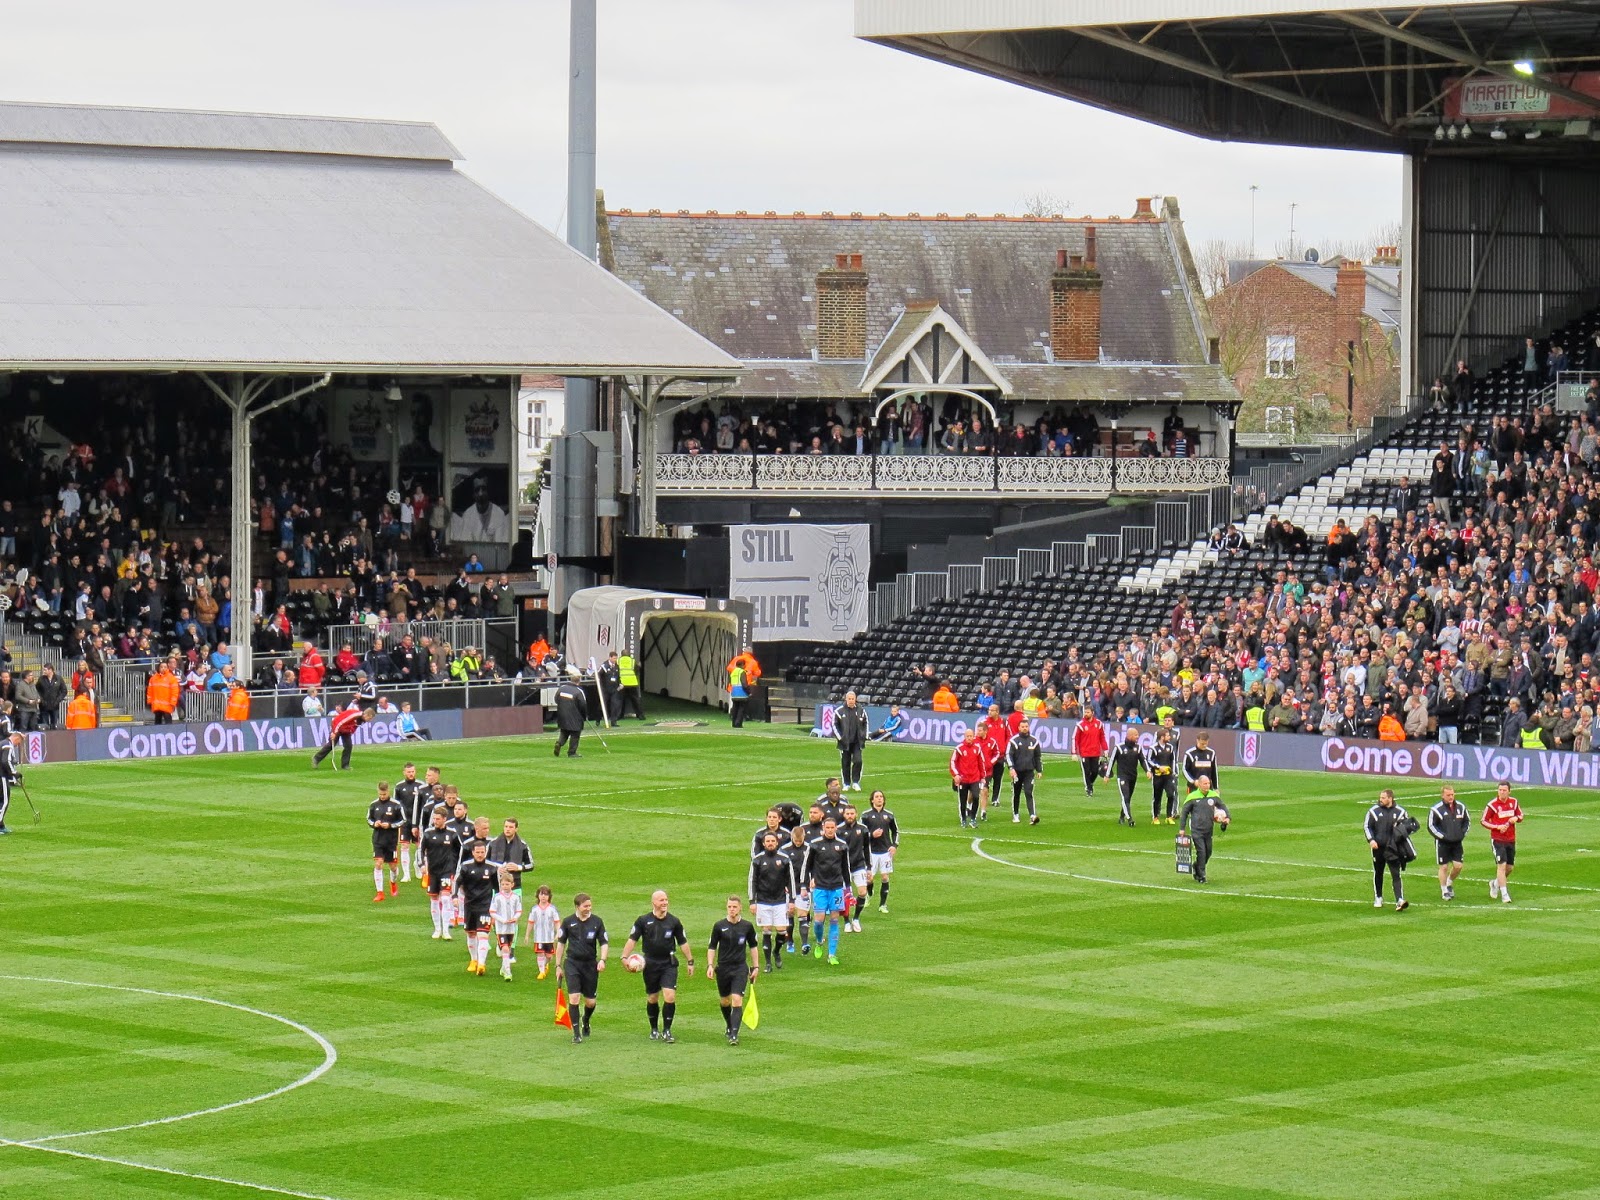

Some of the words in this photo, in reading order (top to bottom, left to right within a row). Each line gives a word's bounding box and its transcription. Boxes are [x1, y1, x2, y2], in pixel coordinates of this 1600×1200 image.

[1494, 101, 1517, 111] BET
[28, 419, 39, 434] K
[741, 528, 794, 563] STILL
[735, 595, 810, 628] ELIEVE
[107, 727, 197, 759] Come
[203, 721, 244, 754] On
[250, 720, 302, 750] You
[1321, 737, 1412, 775] Come
[1420, 743, 1464, 777] On
[1474, 747, 1530, 782] You
